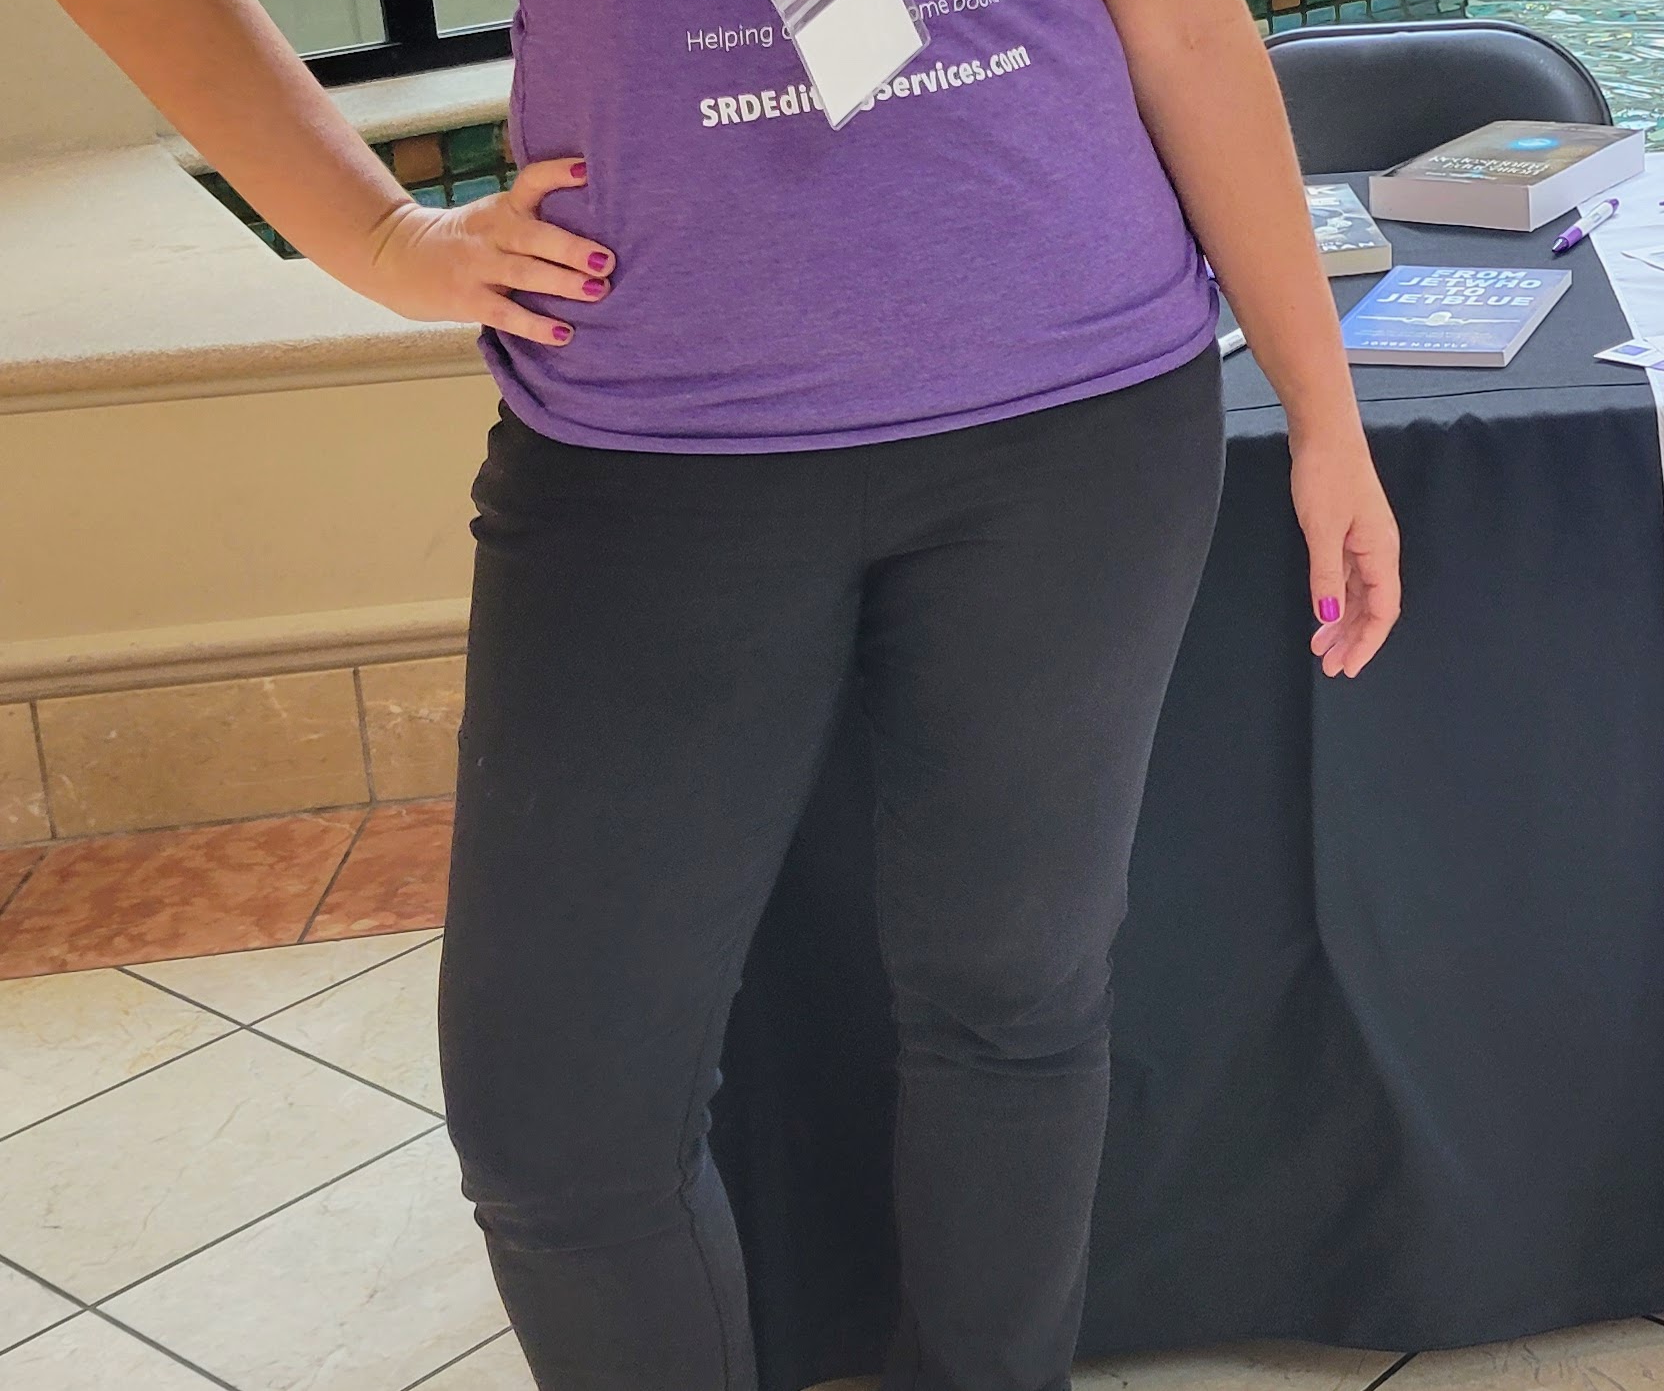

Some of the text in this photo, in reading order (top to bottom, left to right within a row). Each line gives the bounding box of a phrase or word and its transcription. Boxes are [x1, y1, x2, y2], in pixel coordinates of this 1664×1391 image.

[687, 23, 773, 52] Helping
[700, 44, 1032, 127] SRDEditServices.com
[1431, 269, 1528, 279] FROM
[1399, 277, 1542, 289] JETWHO
[1446, 286, 1486, 296] TO
[1376, 293, 1534, 306] JETBLUE
